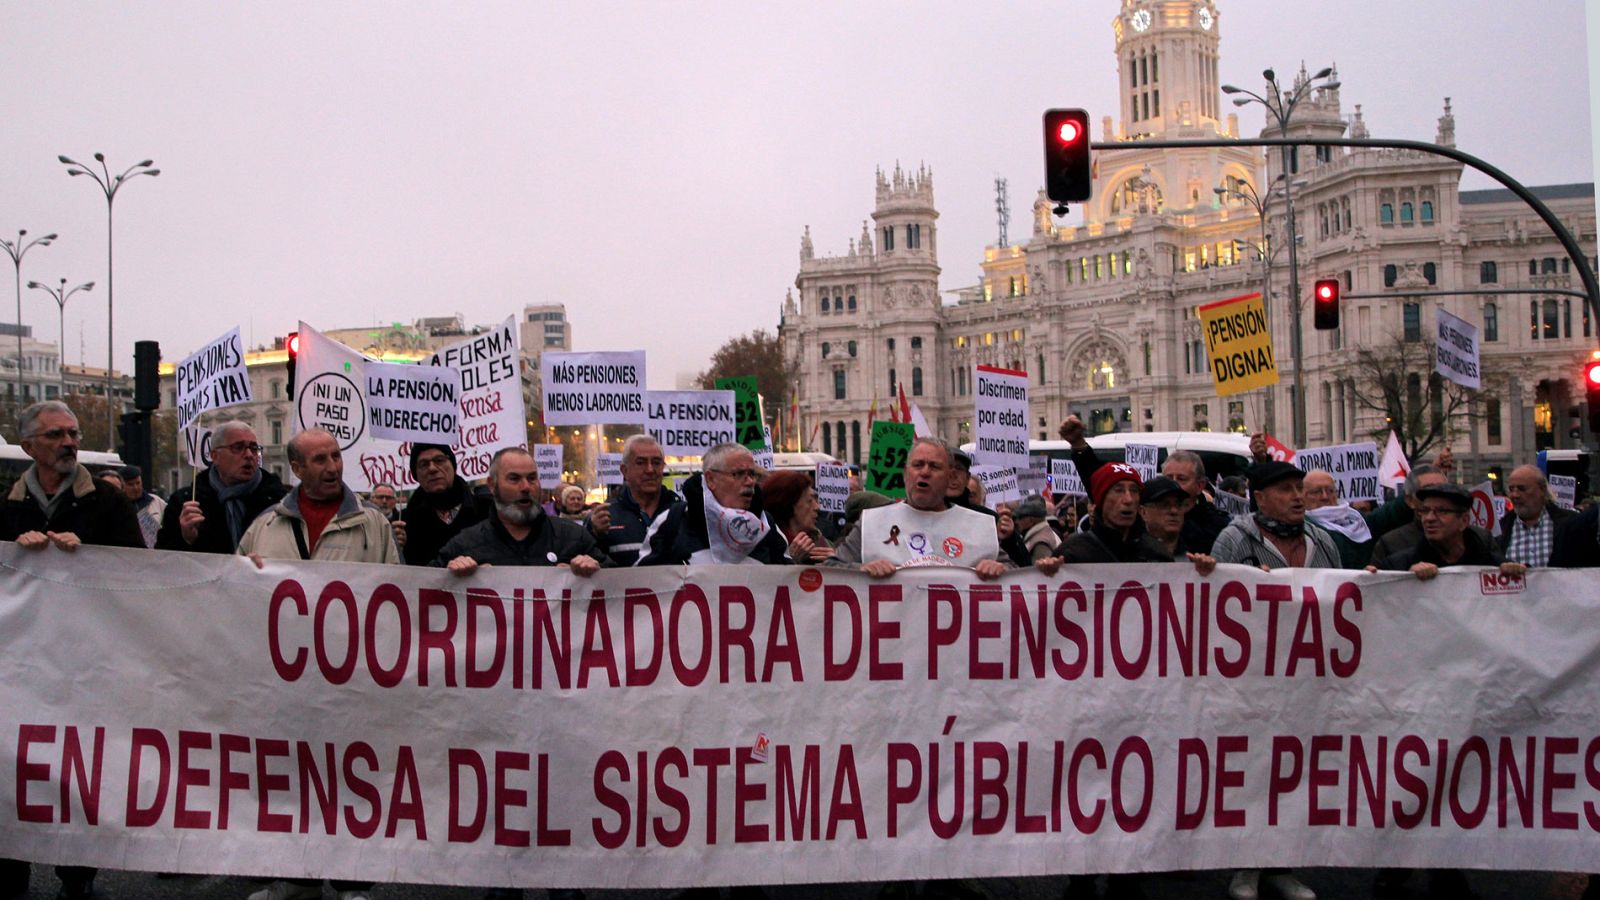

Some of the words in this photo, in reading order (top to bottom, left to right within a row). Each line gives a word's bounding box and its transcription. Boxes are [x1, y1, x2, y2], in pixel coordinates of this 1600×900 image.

[1207, 304, 1266, 352] ¡PENSIÓN
[178, 334, 241, 397] PENSIONES
[461, 354, 514, 392] OLES
[552, 361, 575, 384] MÁS
[577, 364, 639, 388] PENSIONES,
[1214, 345, 1274, 383] DIGNA!
[335, 385, 352, 403] UN
[368, 376, 385, 397] LA
[388, 376, 458, 408] PENSIÓN,
[978, 377, 1026, 401] Discrimen
[179, 386, 209, 430] DIGNAS
[213, 372, 250, 408] ¡YA!
[316, 402, 349, 421] PASO
[548, 392, 584, 412] MENOS
[586, 392, 644, 412] LADRONES.
[648, 402, 666, 420] LA
[669, 399, 734, 424] PENSIÓN,
[370, 407, 382, 427] MI
[384, 408, 456, 434] DERECHO!
[978, 409, 997, 428] por
[998, 408, 1027, 431] edad,
[649, 428, 662, 446] MI
[666, 428, 733, 447] DERECHO!
[979, 436, 1006, 453] nunca
[1007, 435, 1028, 455] más.
[871, 446, 908, 469] +52
[1300, 451, 1334, 473] ROBAR
[1335, 453, 1345, 473] al
[1347, 450, 1376, 470] MAYOR
[820, 466, 849, 479] BLINDAR
[870, 468, 906, 490] YA
[989, 468, 1012, 480] somos
[1054, 477, 1077, 492] VILEZA
[1350, 476, 1379, 498] ATROZ.
[268, 579, 804, 691] COORDINADORA
[823, 583, 904, 682] DE
[927, 580, 1363, 681] PENSIONISTAS
[16, 724, 105, 827] EN
[126, 728, 427, 841] DEFENSA
[447, 748, 571, 848] DEL
[592, 744, 868, 849] SISTEMA
[888, 715, 1154, 840] PÚBLICO
[1176, 736, 1249, 832] DE
